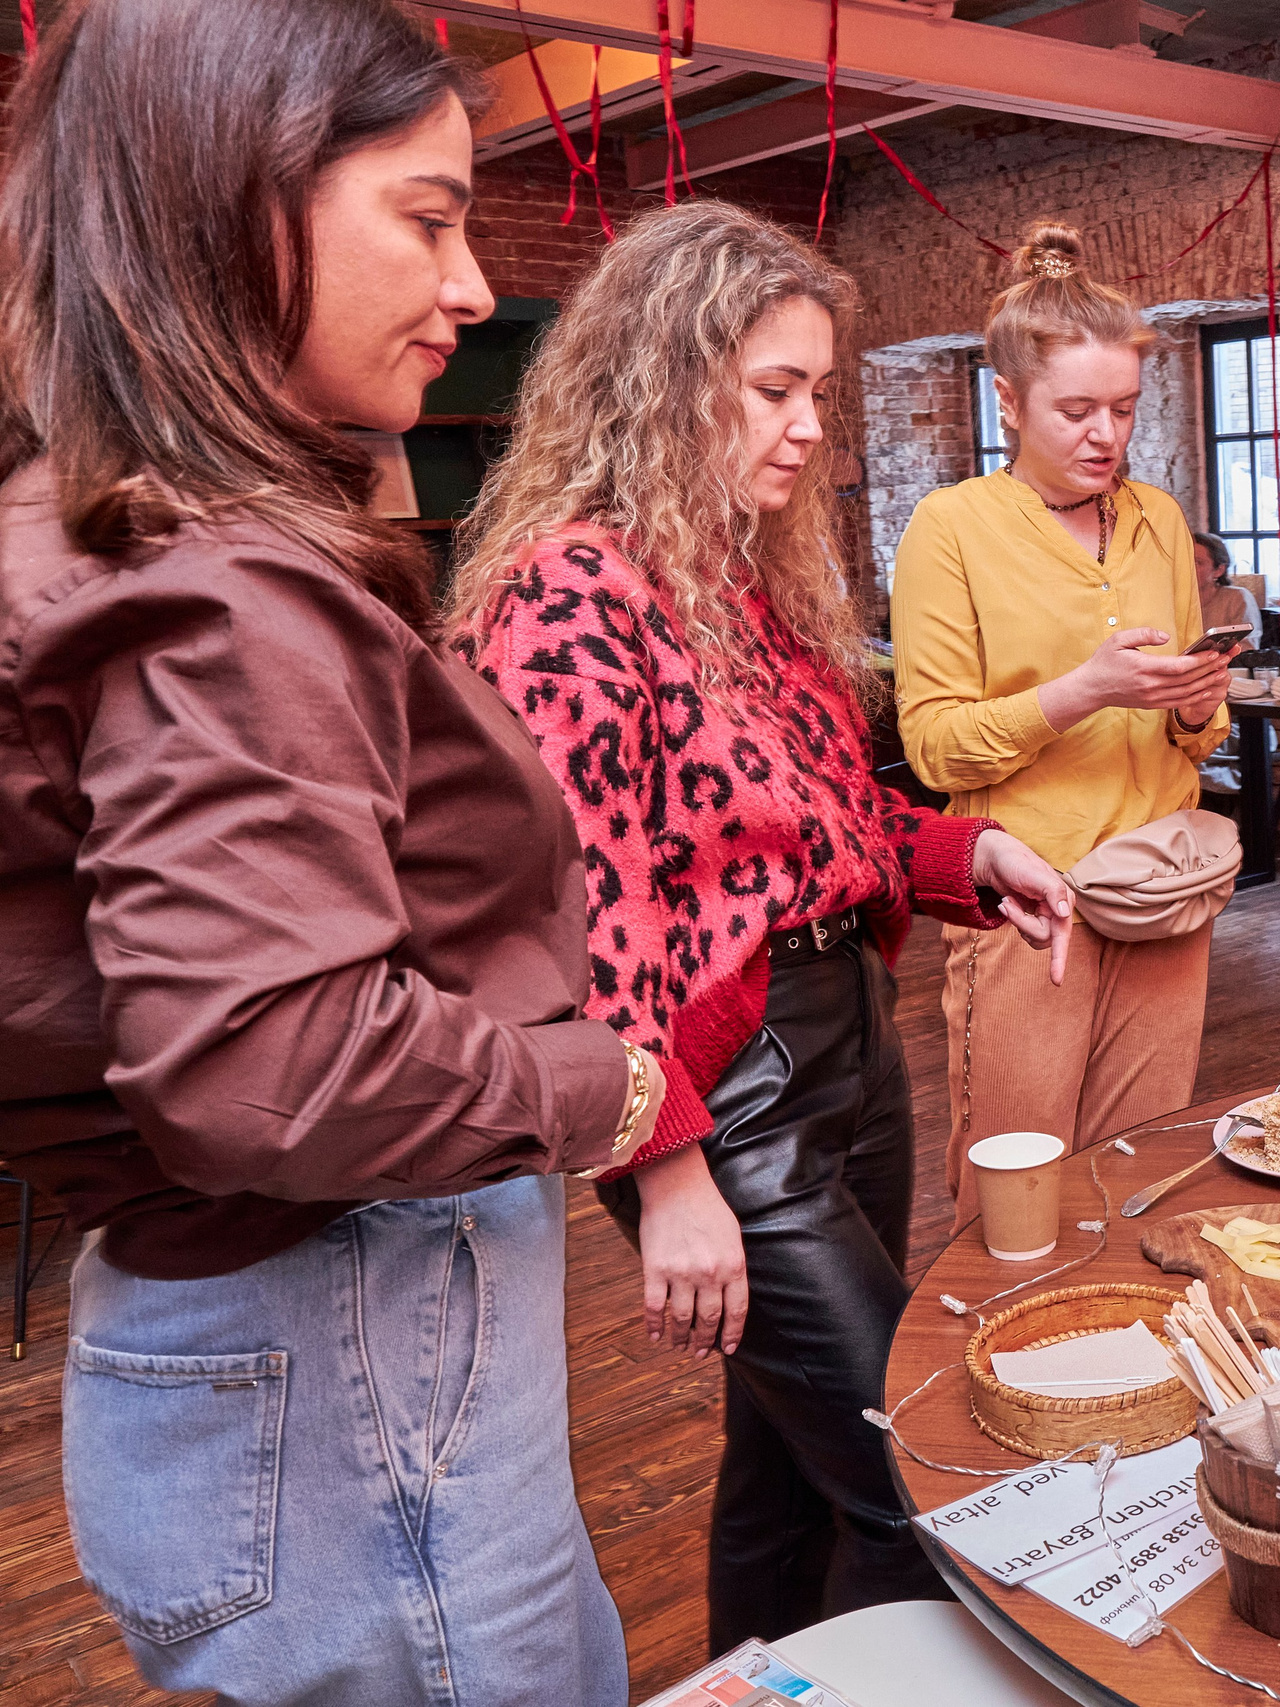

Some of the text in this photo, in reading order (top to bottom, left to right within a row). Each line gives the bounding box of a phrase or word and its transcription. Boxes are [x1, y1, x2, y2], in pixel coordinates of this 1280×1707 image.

[930, 1466, 1068, 1532] ved_altay
[1161, 1513, 1205, 1544] 9138
[1118, 1542, 1167, 1574] 3891
[1073, 1573, 1122, 1607] 4022
[1099, 1538, 1221, 1625] 82 34 08 инькоф
